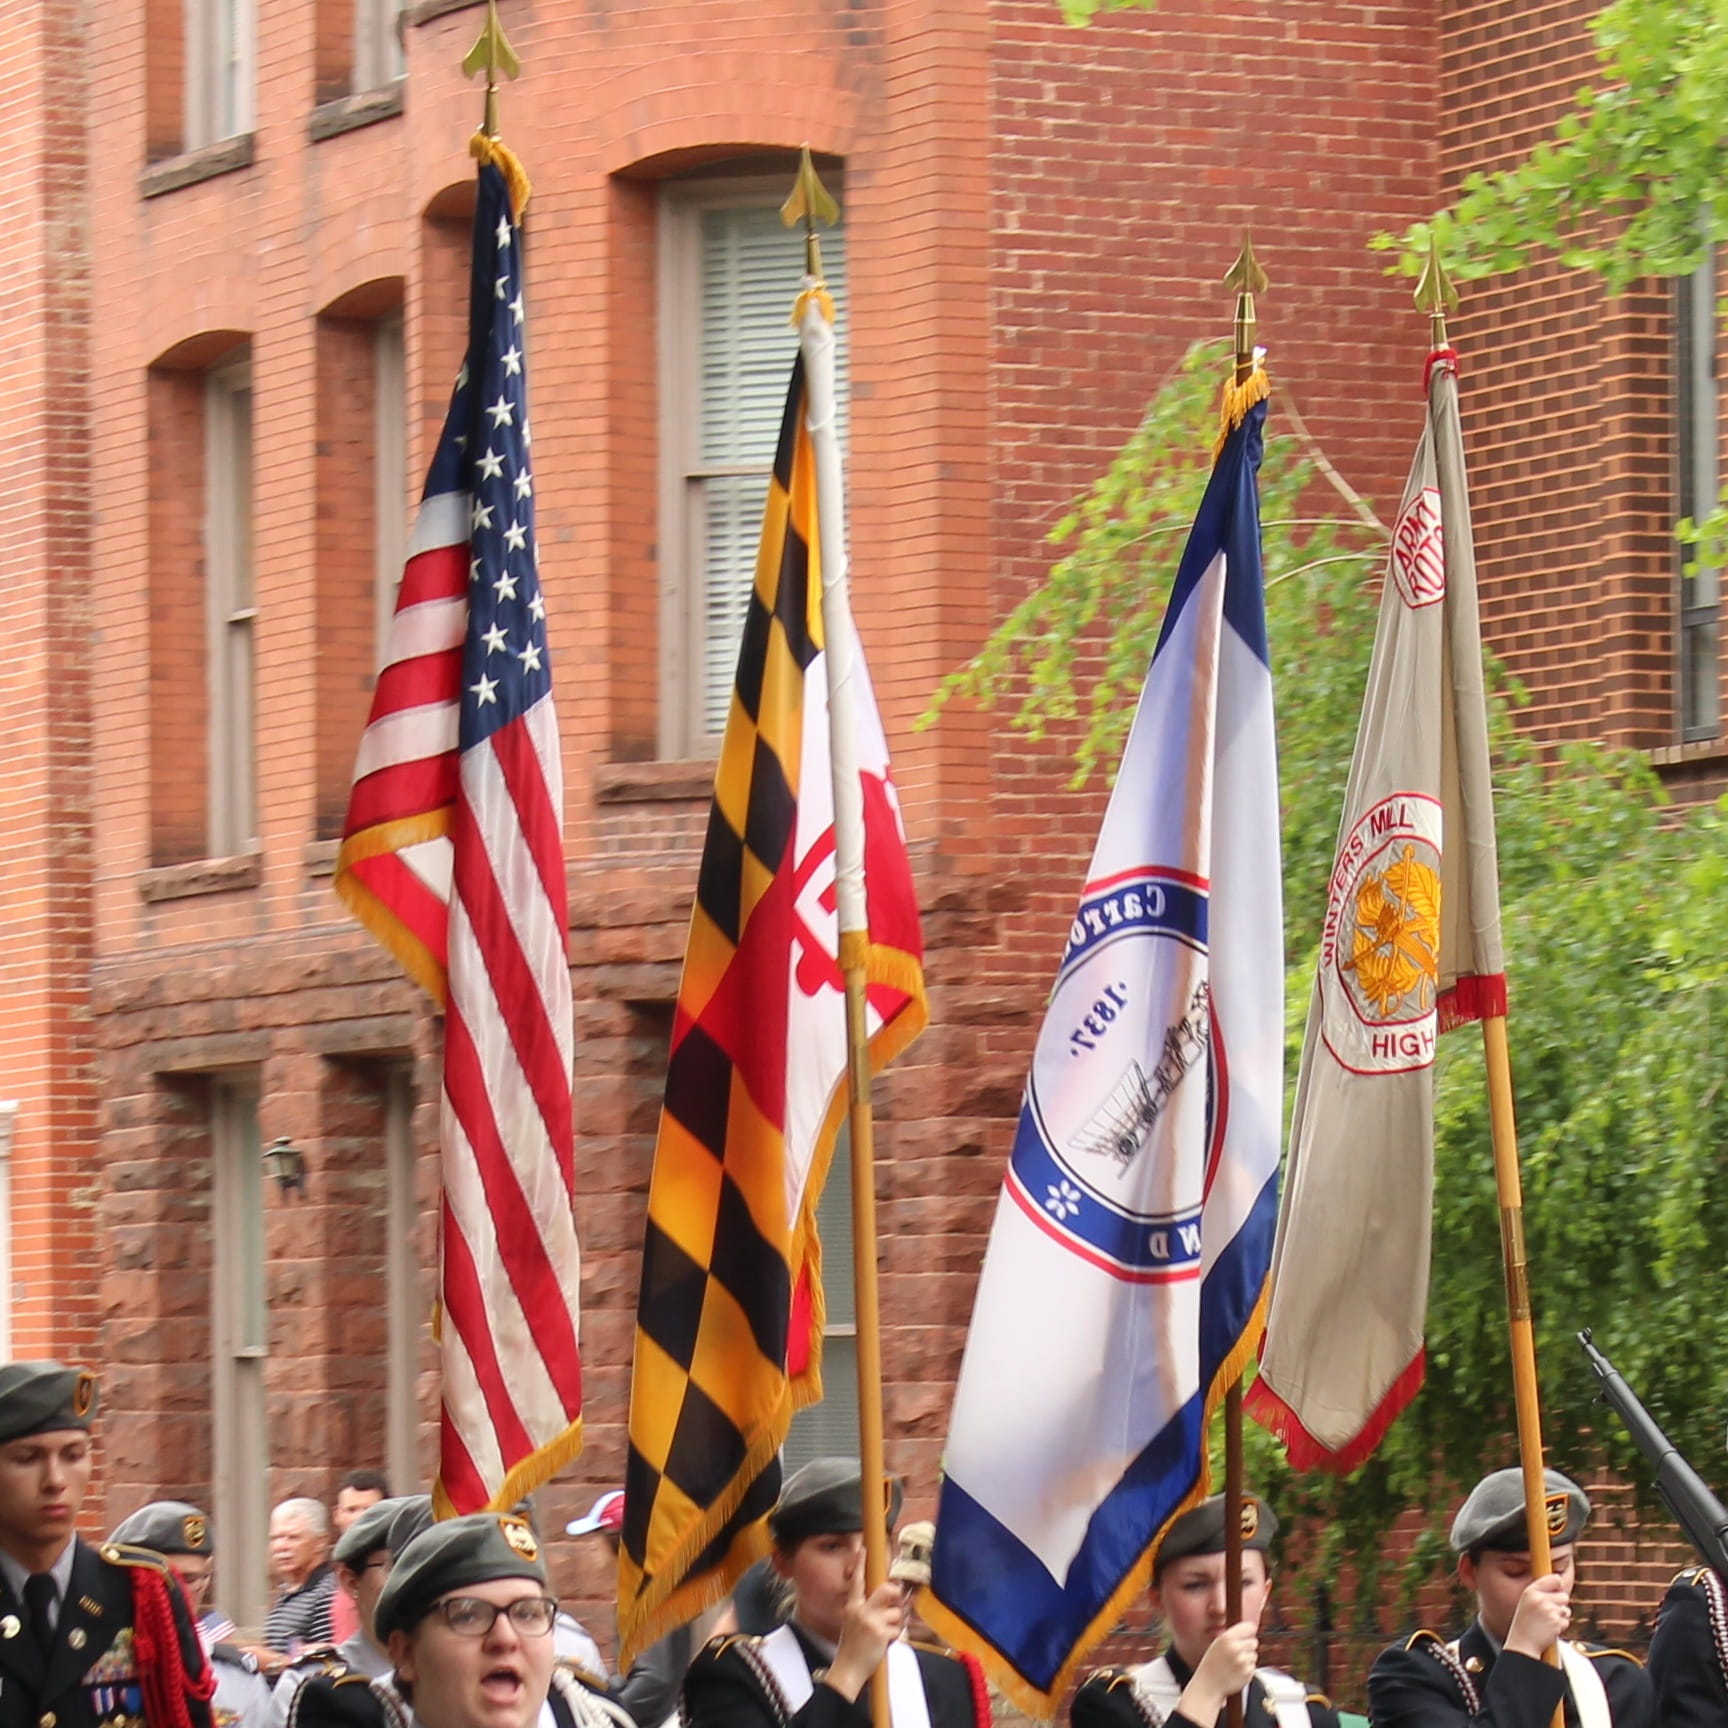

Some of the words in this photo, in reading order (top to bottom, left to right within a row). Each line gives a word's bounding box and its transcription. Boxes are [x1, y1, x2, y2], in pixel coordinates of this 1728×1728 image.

[1395, 500, 1437, 579] ARMY
[1322, 834, 1364, 968] WINTERS
[1371, 804, 1414, 837] MILL
[1372, 1029, 1433, 1058] HIGH
